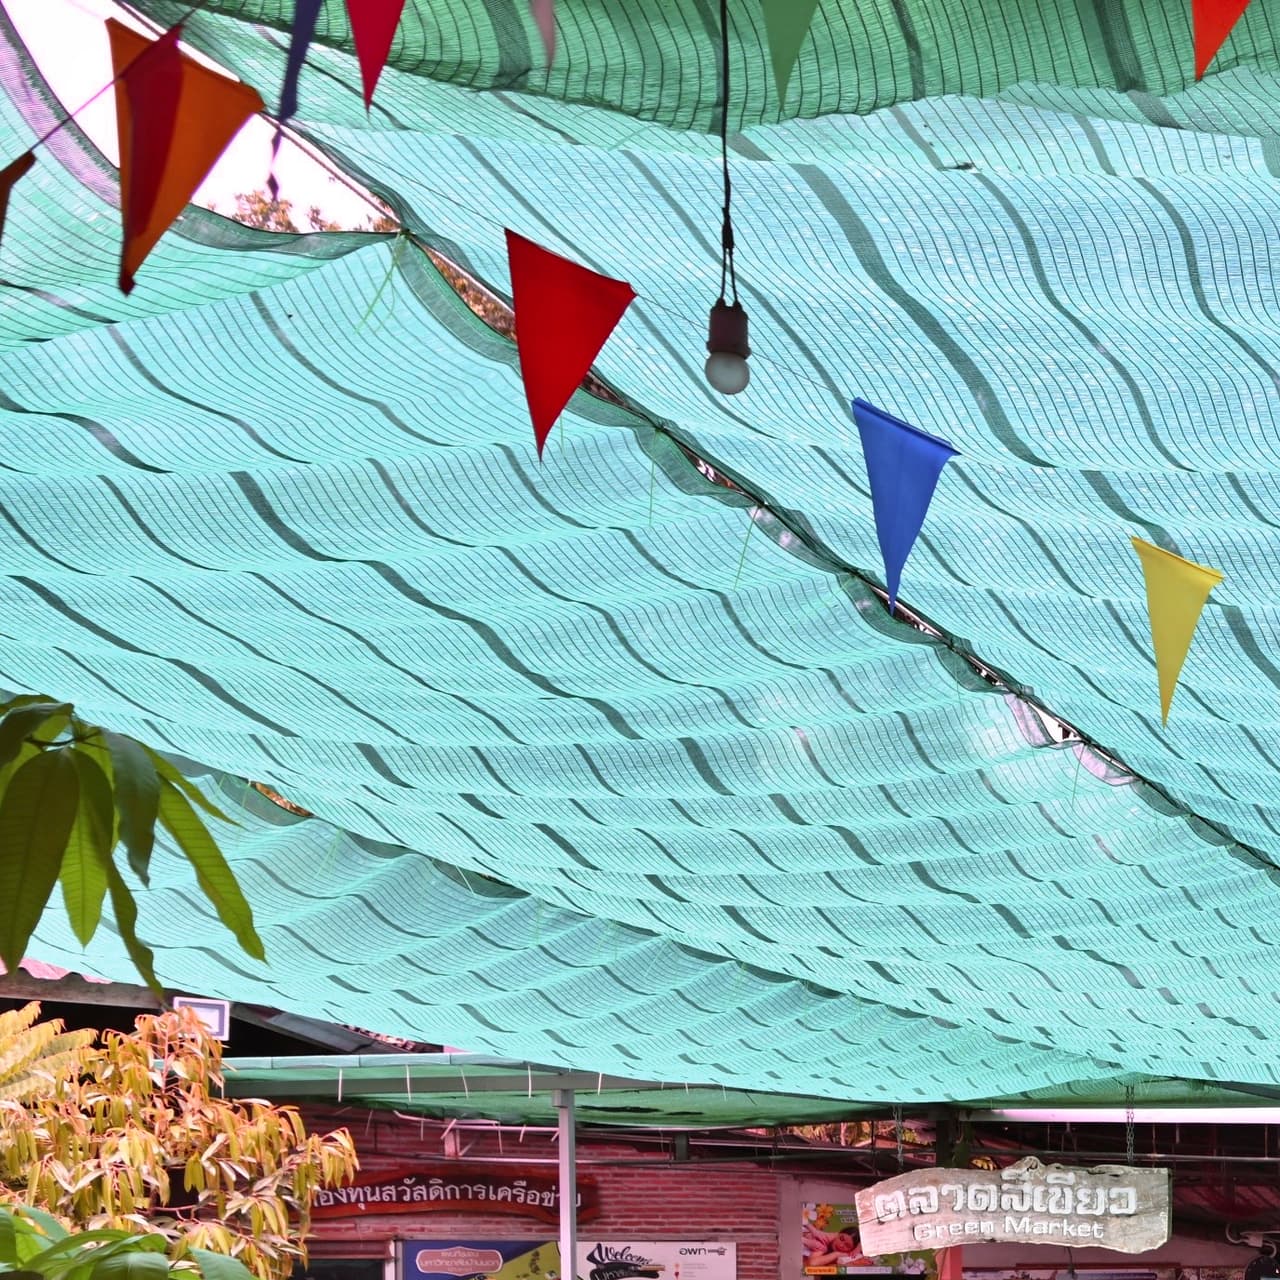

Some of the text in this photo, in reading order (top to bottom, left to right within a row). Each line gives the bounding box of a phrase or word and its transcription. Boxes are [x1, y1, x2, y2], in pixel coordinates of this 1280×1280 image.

[312, 1177, 581, 1211] องทุนสวัสดิการเครือข่
[874, 1170, 1137, 1222] ตลาดสีเขียว
[913, 1214, 1104, 1241] Green Market
